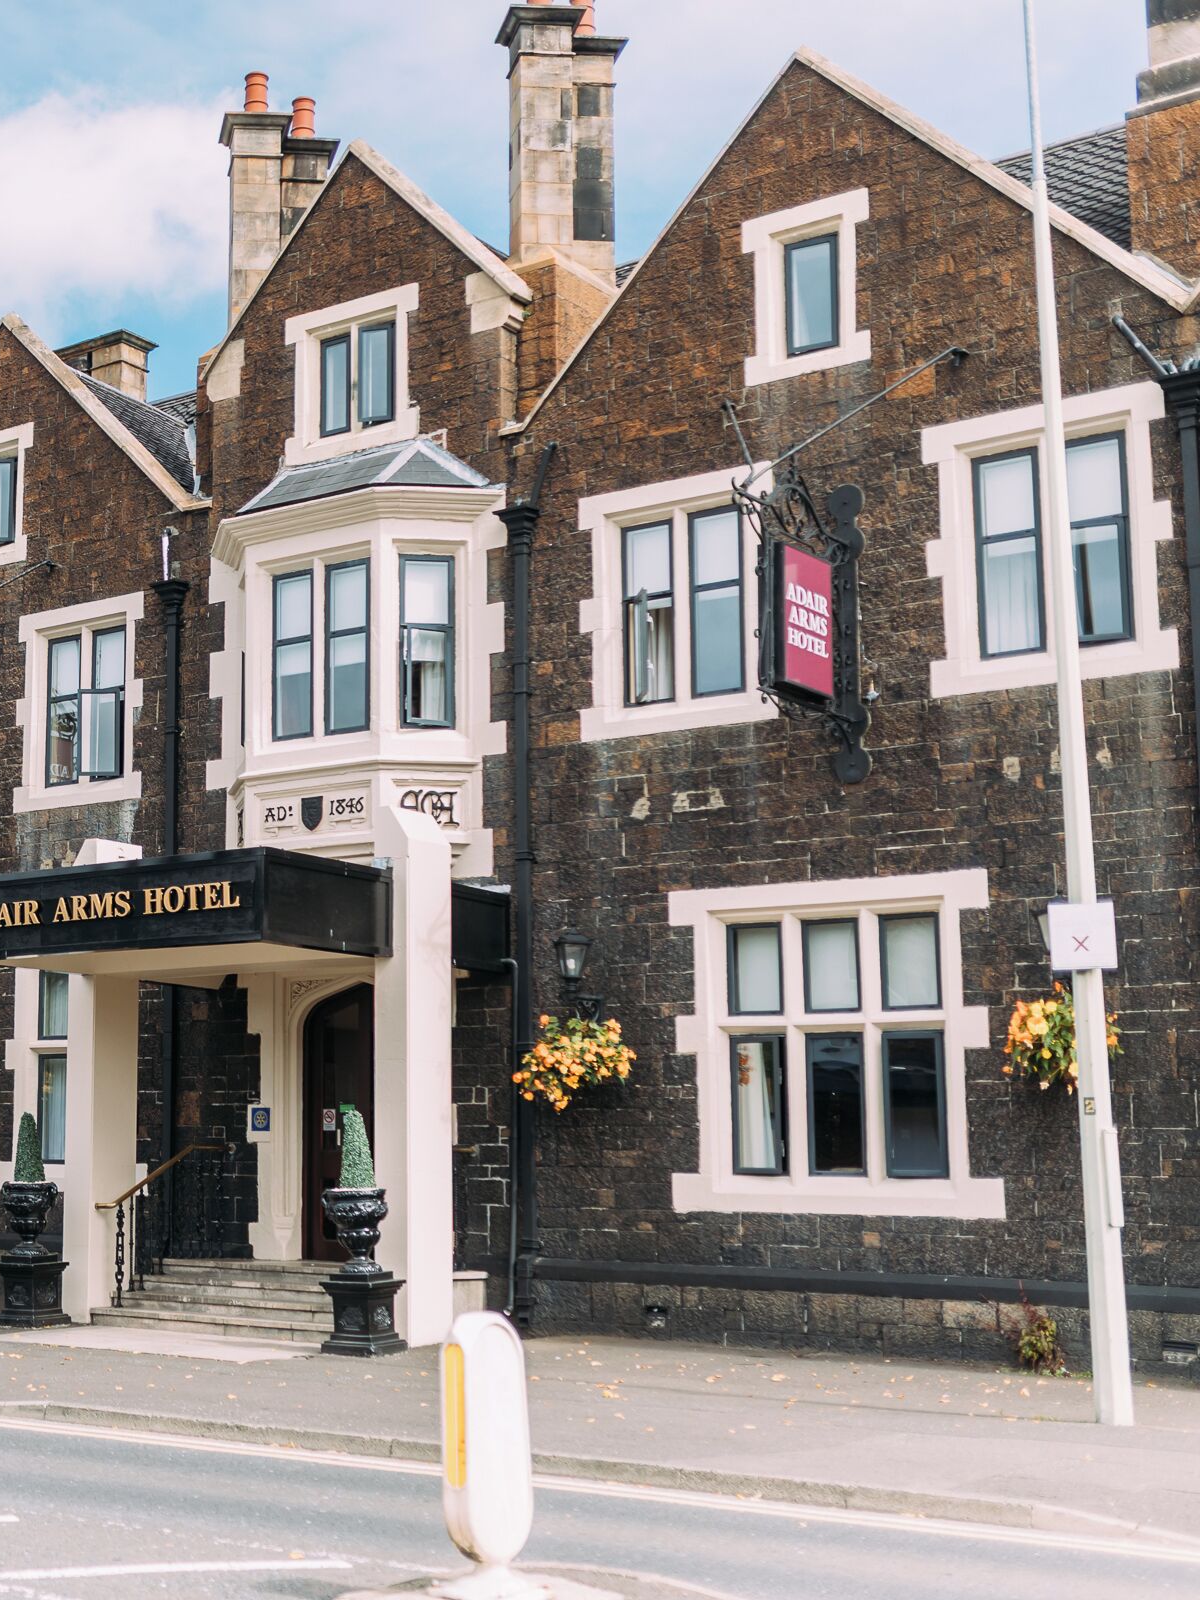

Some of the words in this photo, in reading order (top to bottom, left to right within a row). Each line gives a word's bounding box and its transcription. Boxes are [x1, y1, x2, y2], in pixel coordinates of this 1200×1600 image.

[785, 582, 830, 617] ADAIR
[789, 605, 828, 637] ARMS
[787, 626, 829, 659] HOTEL
[329, 796, 365, 816] 1846
[52, 890, 132, 923] ARMS
[142, 881, 240, 915] HOTEL
